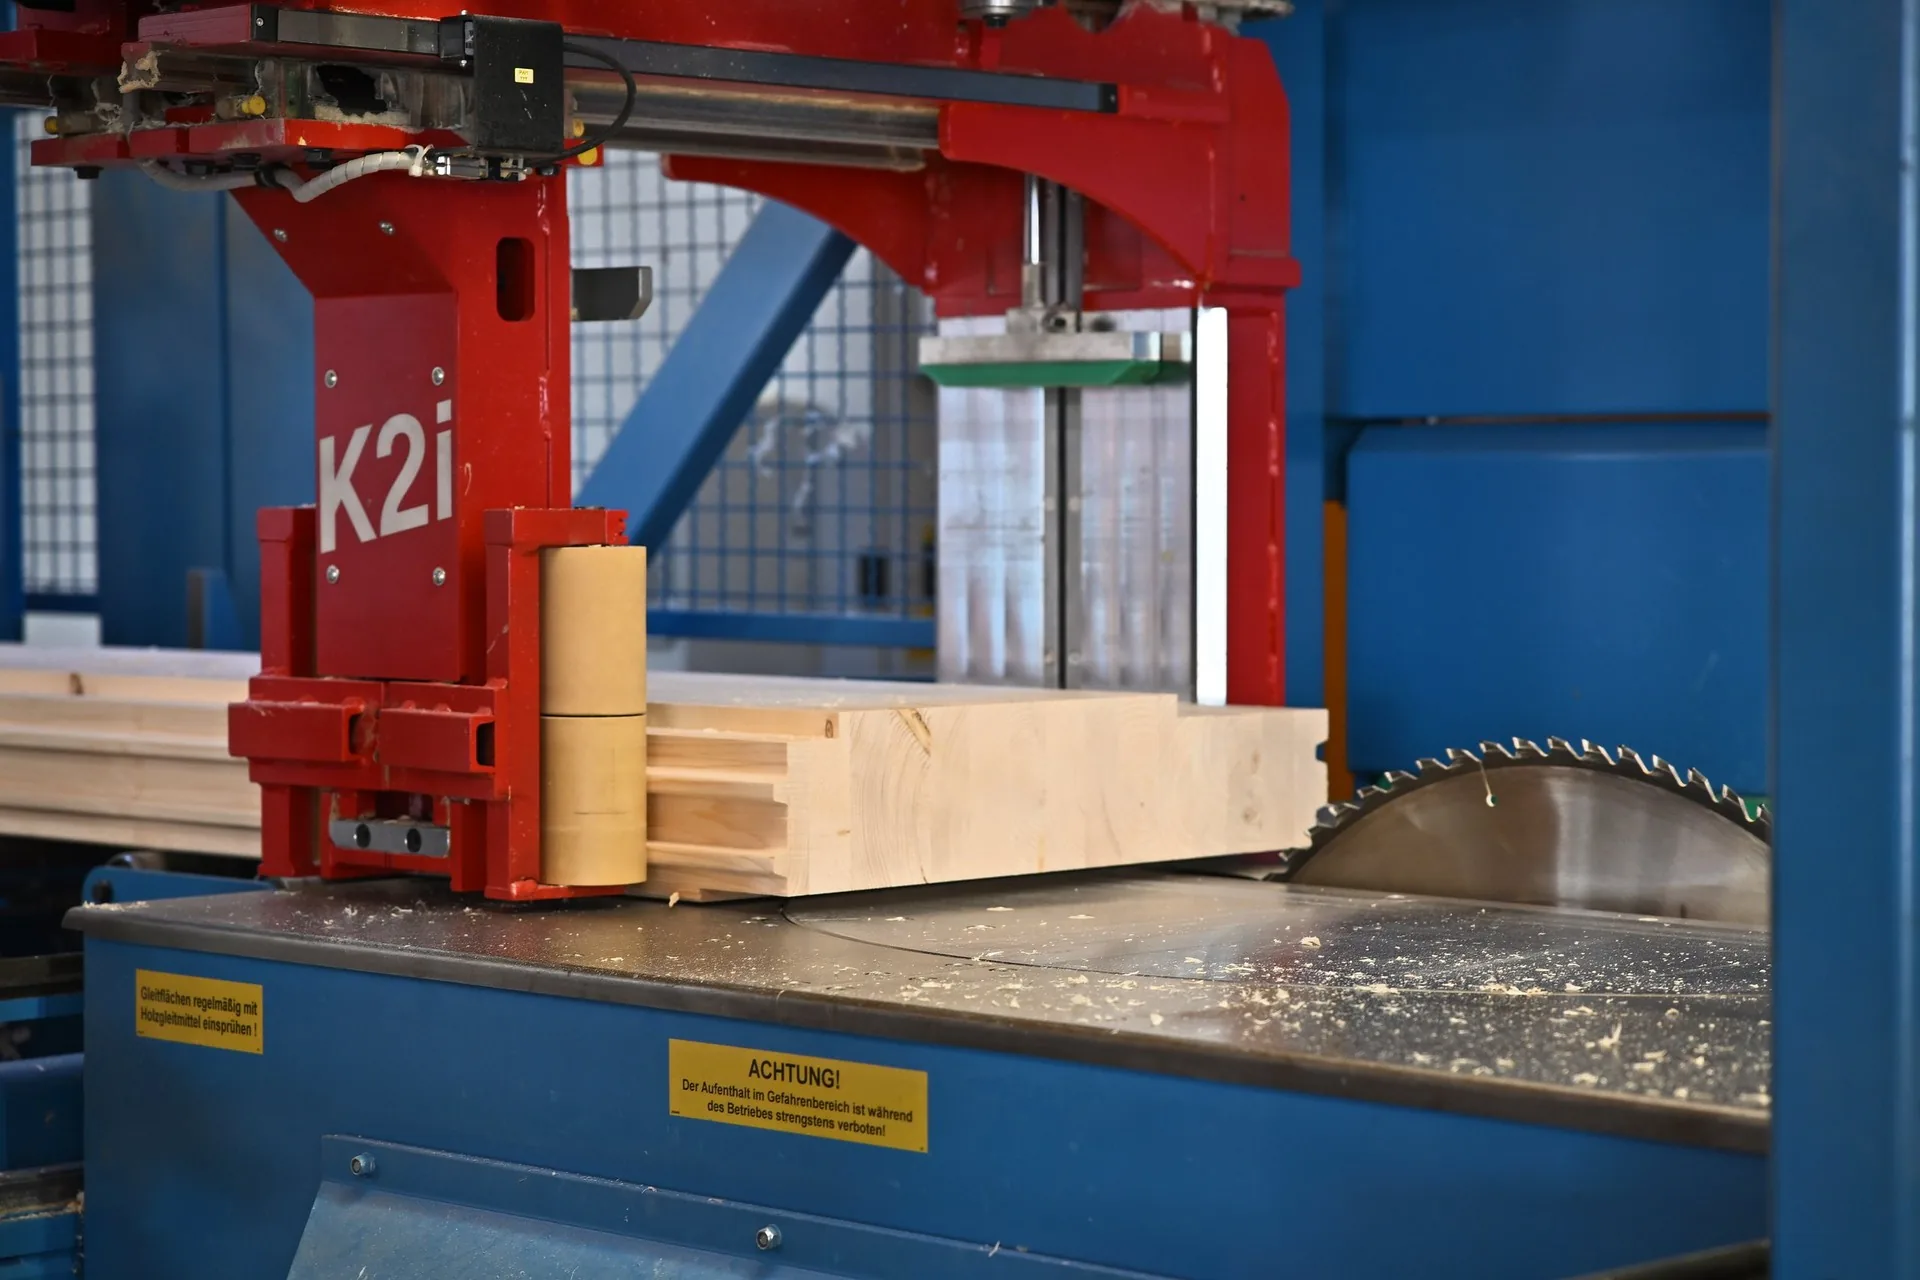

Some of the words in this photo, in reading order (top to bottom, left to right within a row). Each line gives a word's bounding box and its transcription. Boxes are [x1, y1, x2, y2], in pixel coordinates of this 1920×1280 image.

[319, 398, 452, 554] K2i
[140, 986, 191, 1007] Gleitflächen
[193, 996, 241, 1017] regelmäßig
[243, 1001, 258, 1016] mit
[140, 1006, 201, 1029] Holzgleitmittel
[203, 1017, 252, 1036] einsprühen
[748, 1058, 840, 1090] ACHTUNG!
[682, 1078, 699, 1092] Der
[701, 1081, 751, 1100] Aufenthalt
[752, 1088, 765, 1101] im
[767, 1090, 850, 1114] Gefahrenbereich
[852, 1102, 865, 1116] ist
[867, 1106, 913, 1123] während
[707, 1100, 724, 1113] des
[727, 1102, 773, 1120] Betriebes
[776, 1110, 835, 1129] strengstens
[837, 1120, 886, 1137] verboten!
